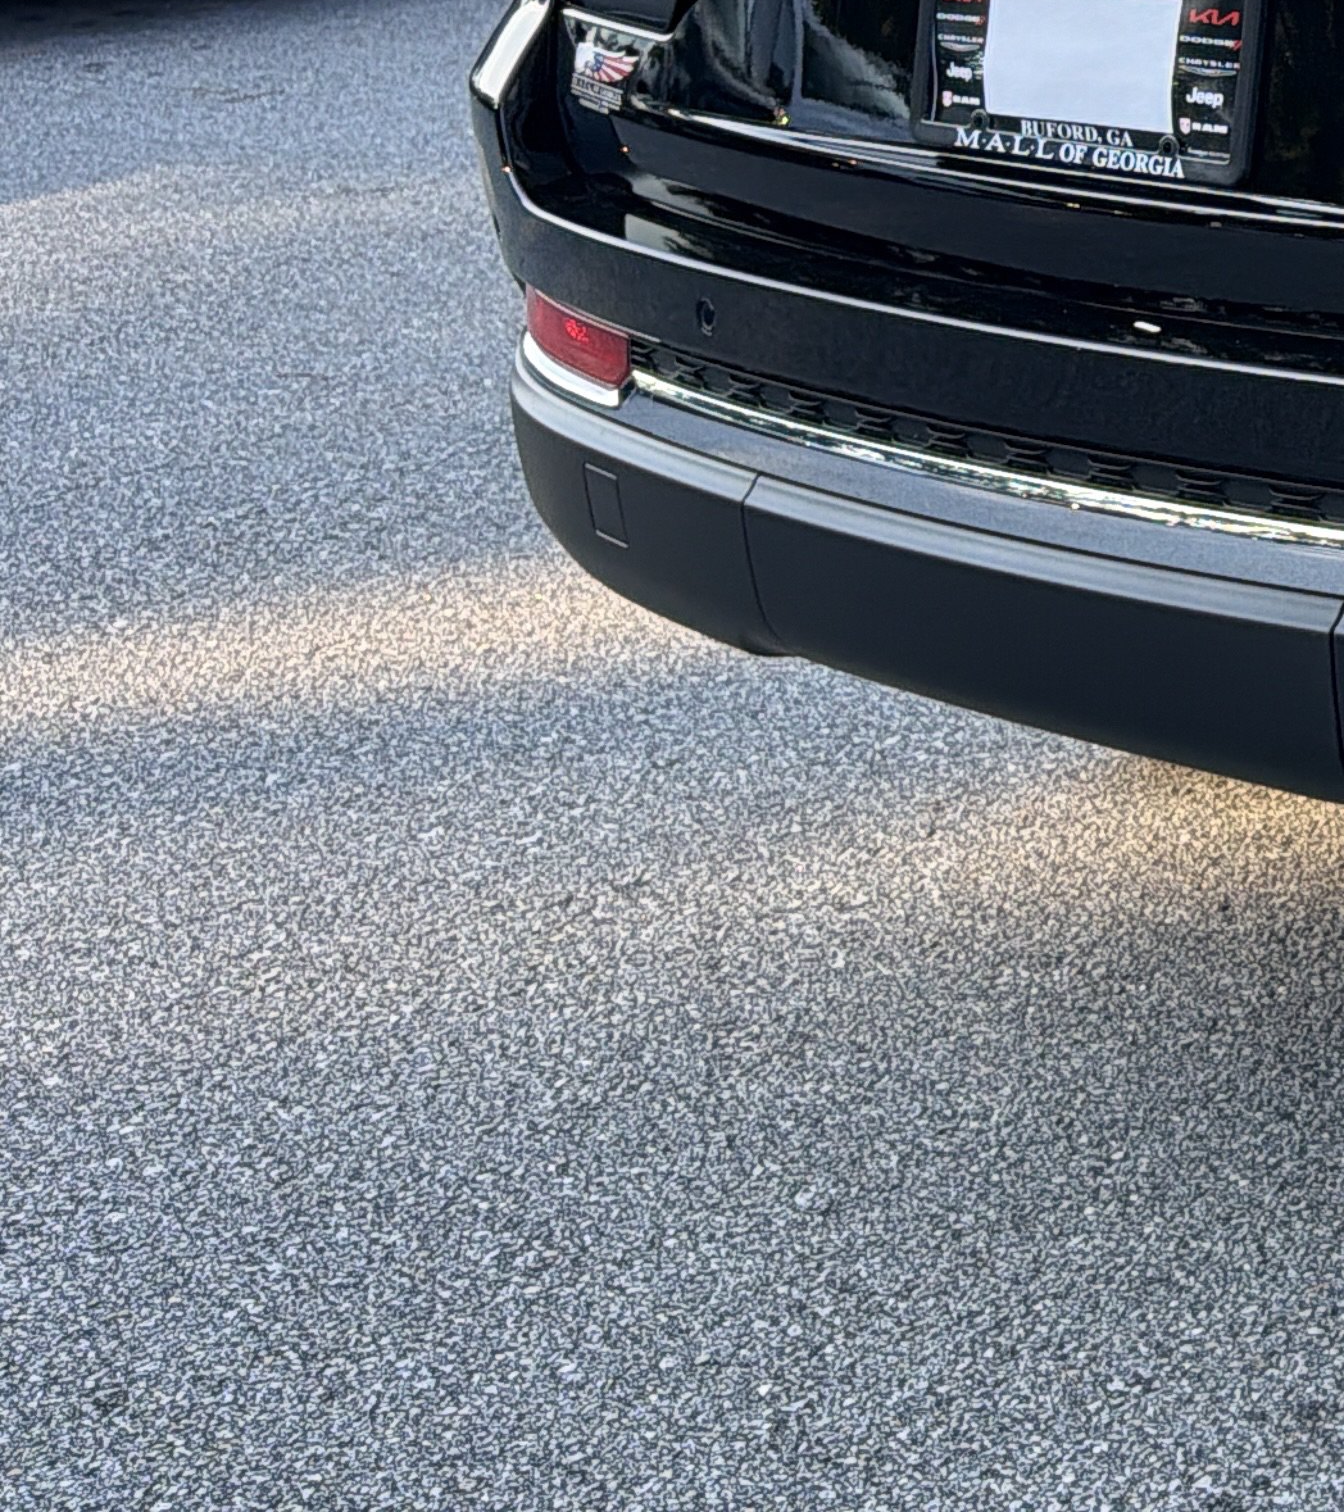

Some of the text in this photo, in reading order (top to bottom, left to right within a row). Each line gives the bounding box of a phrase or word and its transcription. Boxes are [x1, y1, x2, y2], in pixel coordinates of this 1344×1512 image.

[1178, 57, 1241, 69] CHRYSLER
[1185, 87, 1224, 109] Jeep
[1020, 119, 1133, 147] BUFORD, GA
[1058, 143, 1087, 165] OF
[1092, 147, 1185, 179] GEORGIA
